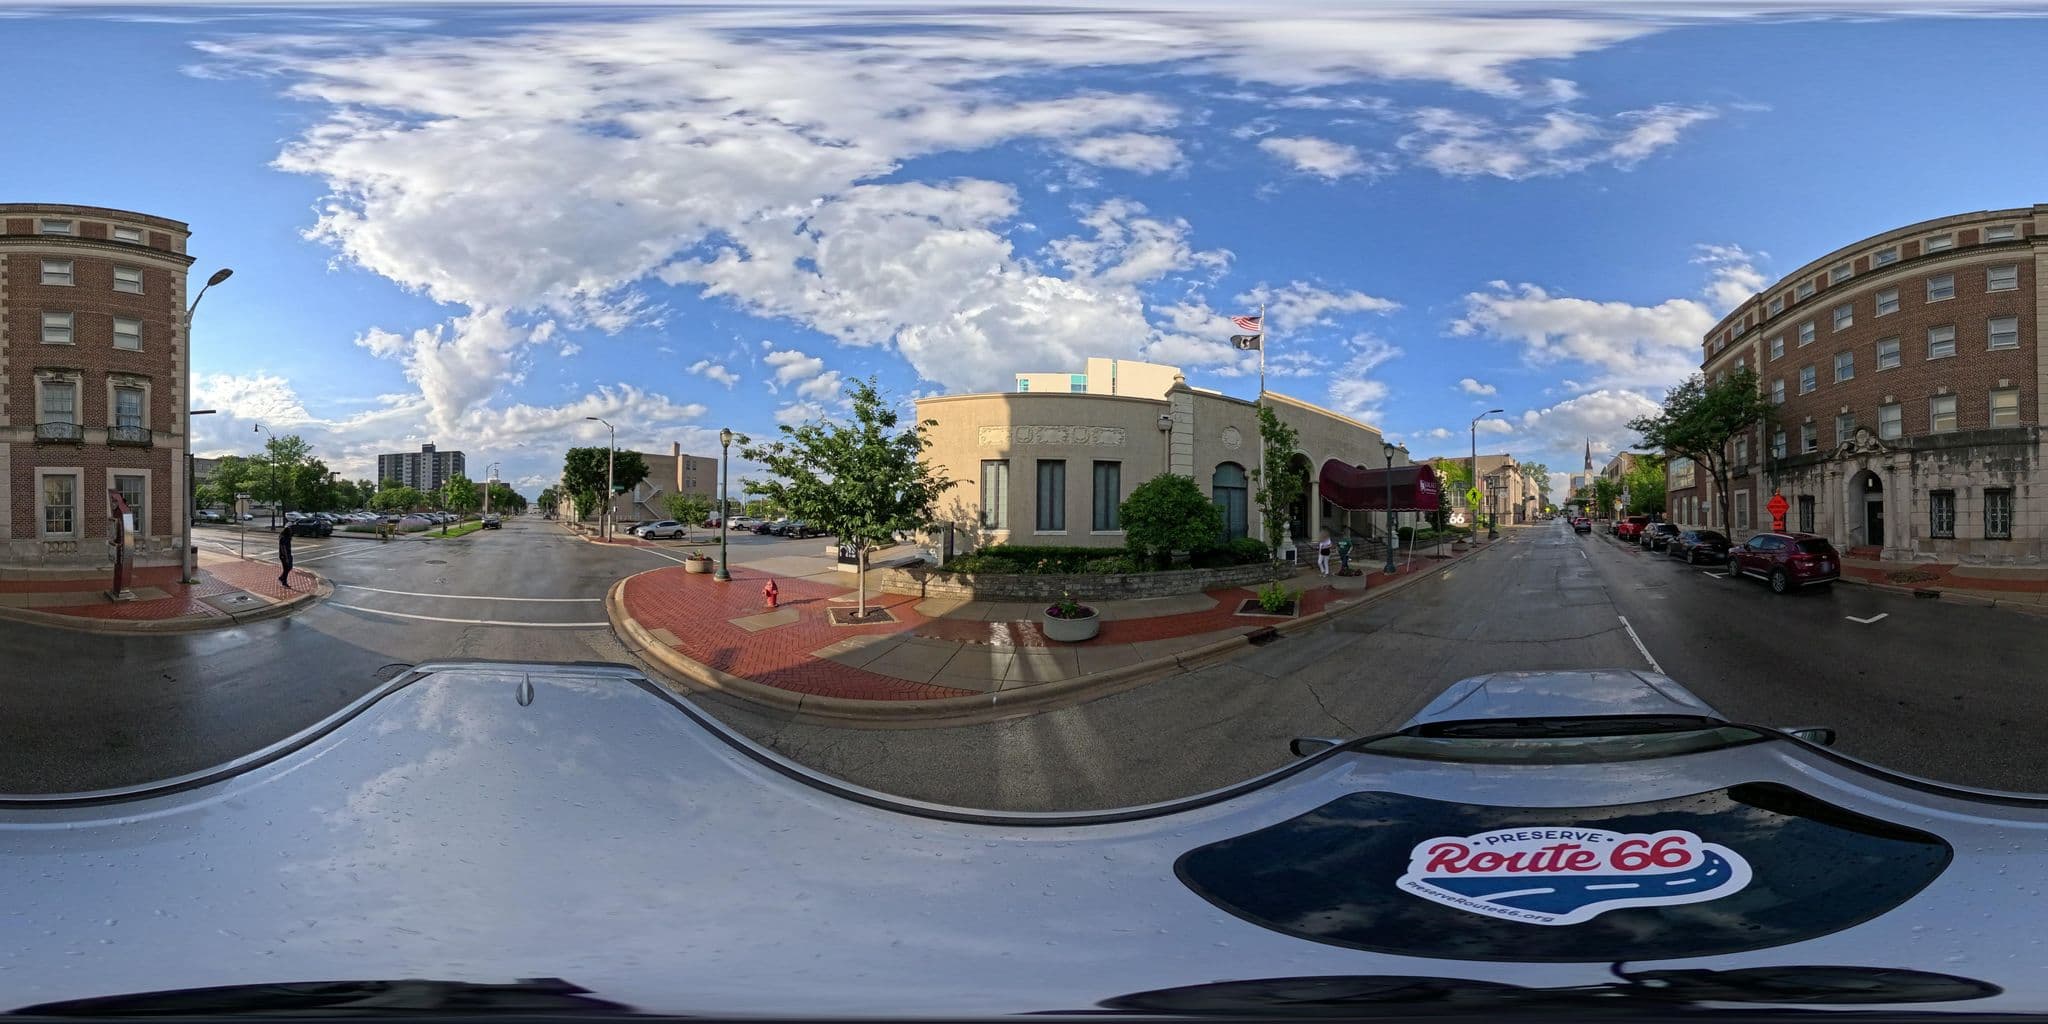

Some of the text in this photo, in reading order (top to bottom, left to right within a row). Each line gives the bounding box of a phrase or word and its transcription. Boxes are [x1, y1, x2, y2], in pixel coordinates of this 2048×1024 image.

[1449, 513, 1465, 525] 66
[1485, 830, 1603, 846] PRESERVE
[1425, 836, 1692, 873] Route 66
